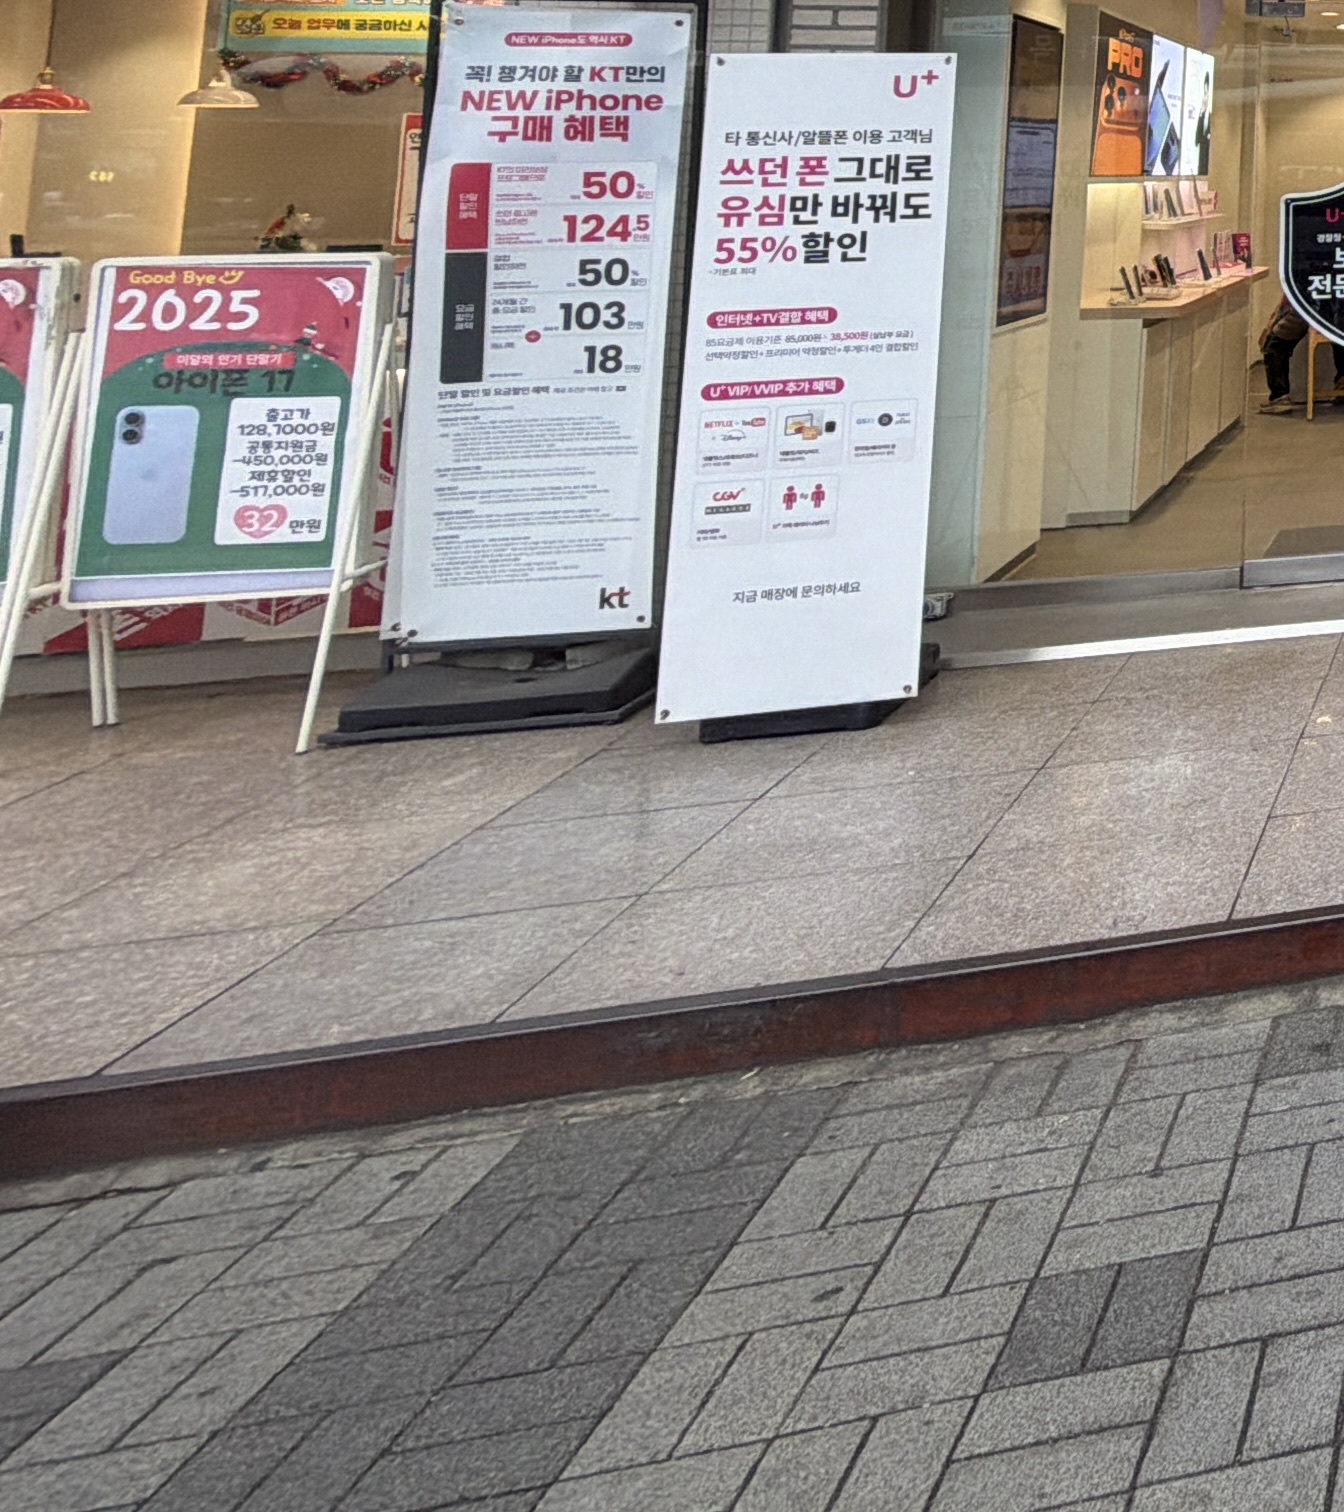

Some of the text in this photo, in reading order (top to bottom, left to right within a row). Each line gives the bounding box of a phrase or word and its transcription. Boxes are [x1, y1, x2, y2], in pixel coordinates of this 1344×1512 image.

[272, 18, 303, 31] 오늘
[307, 18, 351, 31] 업무에
[355, 19, 412, 32] 궁금하신
[511, 35, 538, 44] NEW
[610, 35, 626, 44] KT
[1108, 38, 1144, 78] PRO
[465, 65, 666, 83] 꼭! 챙겨야 할 KT만의
[893, 69, 939, 99] U+
[460, 89, 664, 112] NEW iPhone
[487, 115, 630, 143] 구매 혜택
[725, 131, 741, 146] 타
[853, 129, 884, 145] 이용
[886, 128, 934, 144] 고객님
[719, 153, 934, 188] 쓰던 폰 그대로
[582, 171, 635, 199] 50
[717, 191, 932, 228] 유심만 바꿔도
[713, 230, 868, 265] 55% 할인
[129, 272, 216, 285] Good Bye
[578, 258, 629, 286] 50
[113, 289, 261, 331] 2025
[559, 301, 625, 330] 103
[804, 310, 829, 322] 혜택
[177, 353, 283, 366] 이달의 인기 단말기
[584, 344, 623, 373] 18
[153, 370, 295, 396] 아이폰 17
[266, 409, 311, 422] 출고가
[247, 441, 317, 453] 공통지원금
[242, 509, 322, 533] 32 만원
[599, 587, 631, 610] kt
[733, 582, 861, 604] 지금 매장에 문의하세요
